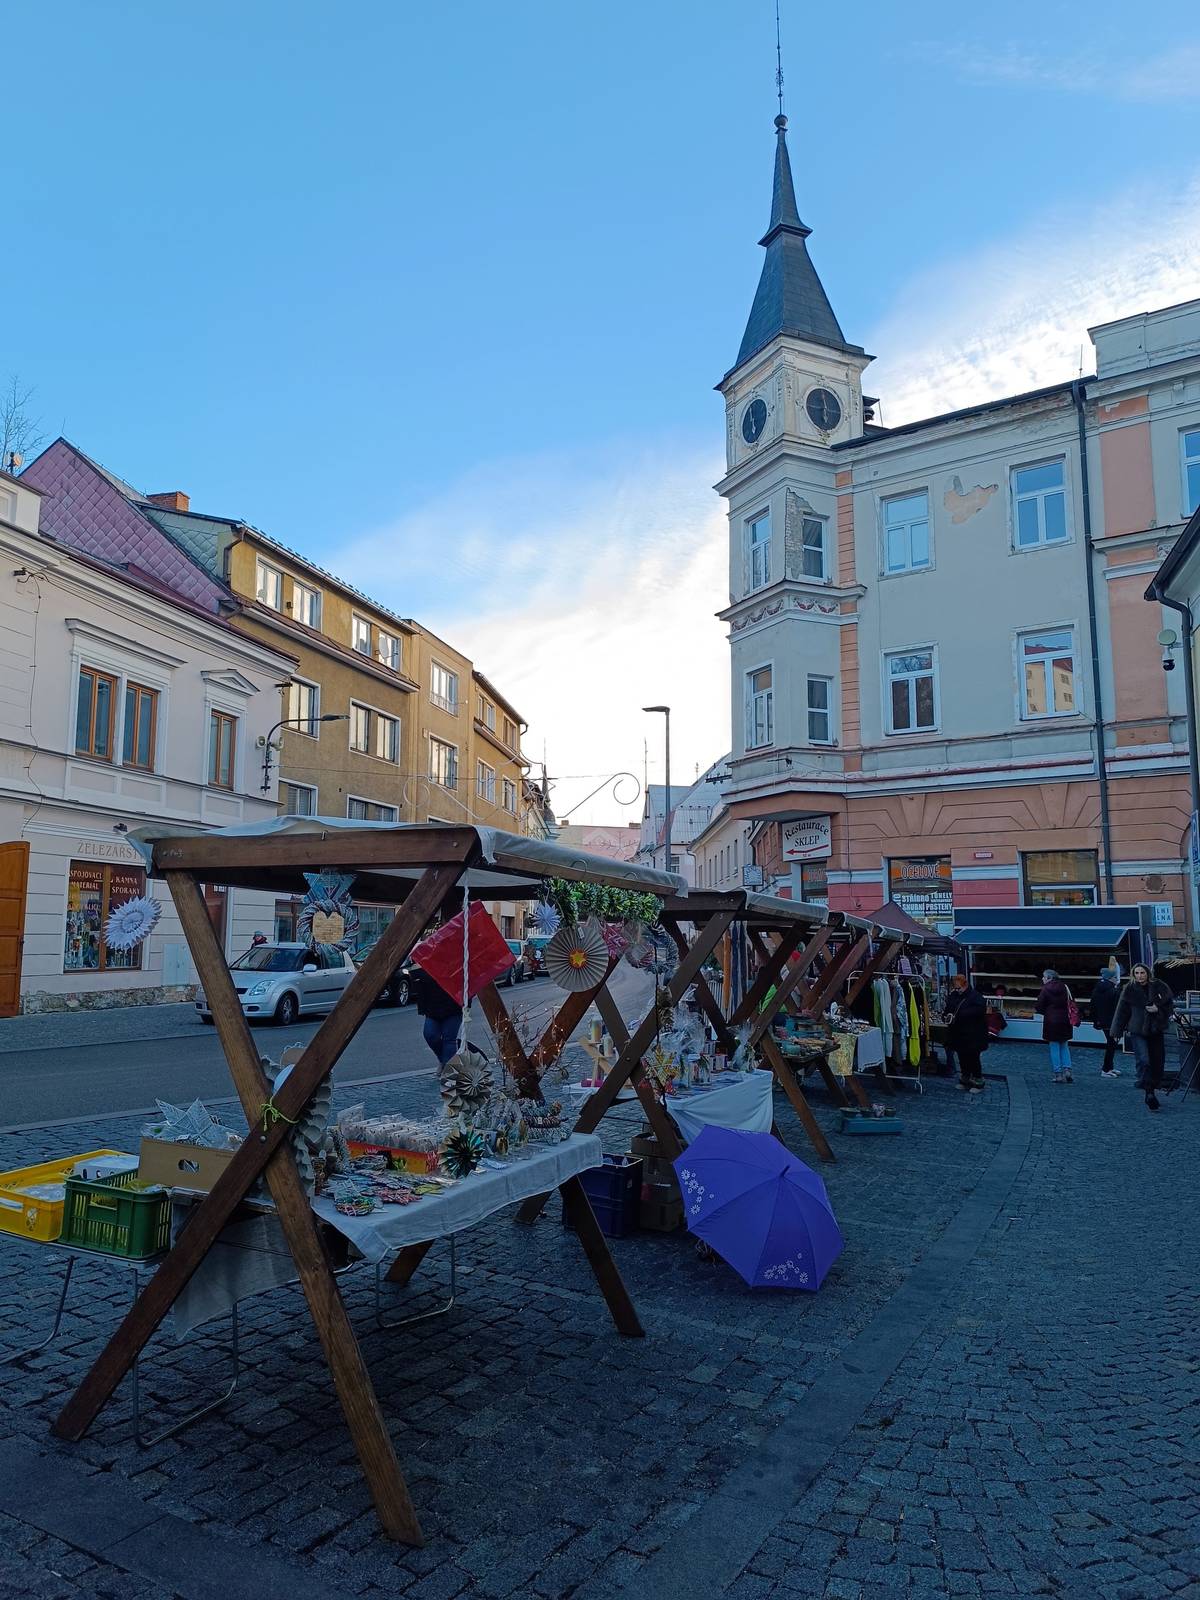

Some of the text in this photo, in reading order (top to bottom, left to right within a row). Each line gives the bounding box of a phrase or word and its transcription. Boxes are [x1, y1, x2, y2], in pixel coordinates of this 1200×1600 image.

[784, 821, 829, 841] Restaurace
[794, 835, 820, 847] SKLEP
[115, 876, 138, 885] KAMNA
